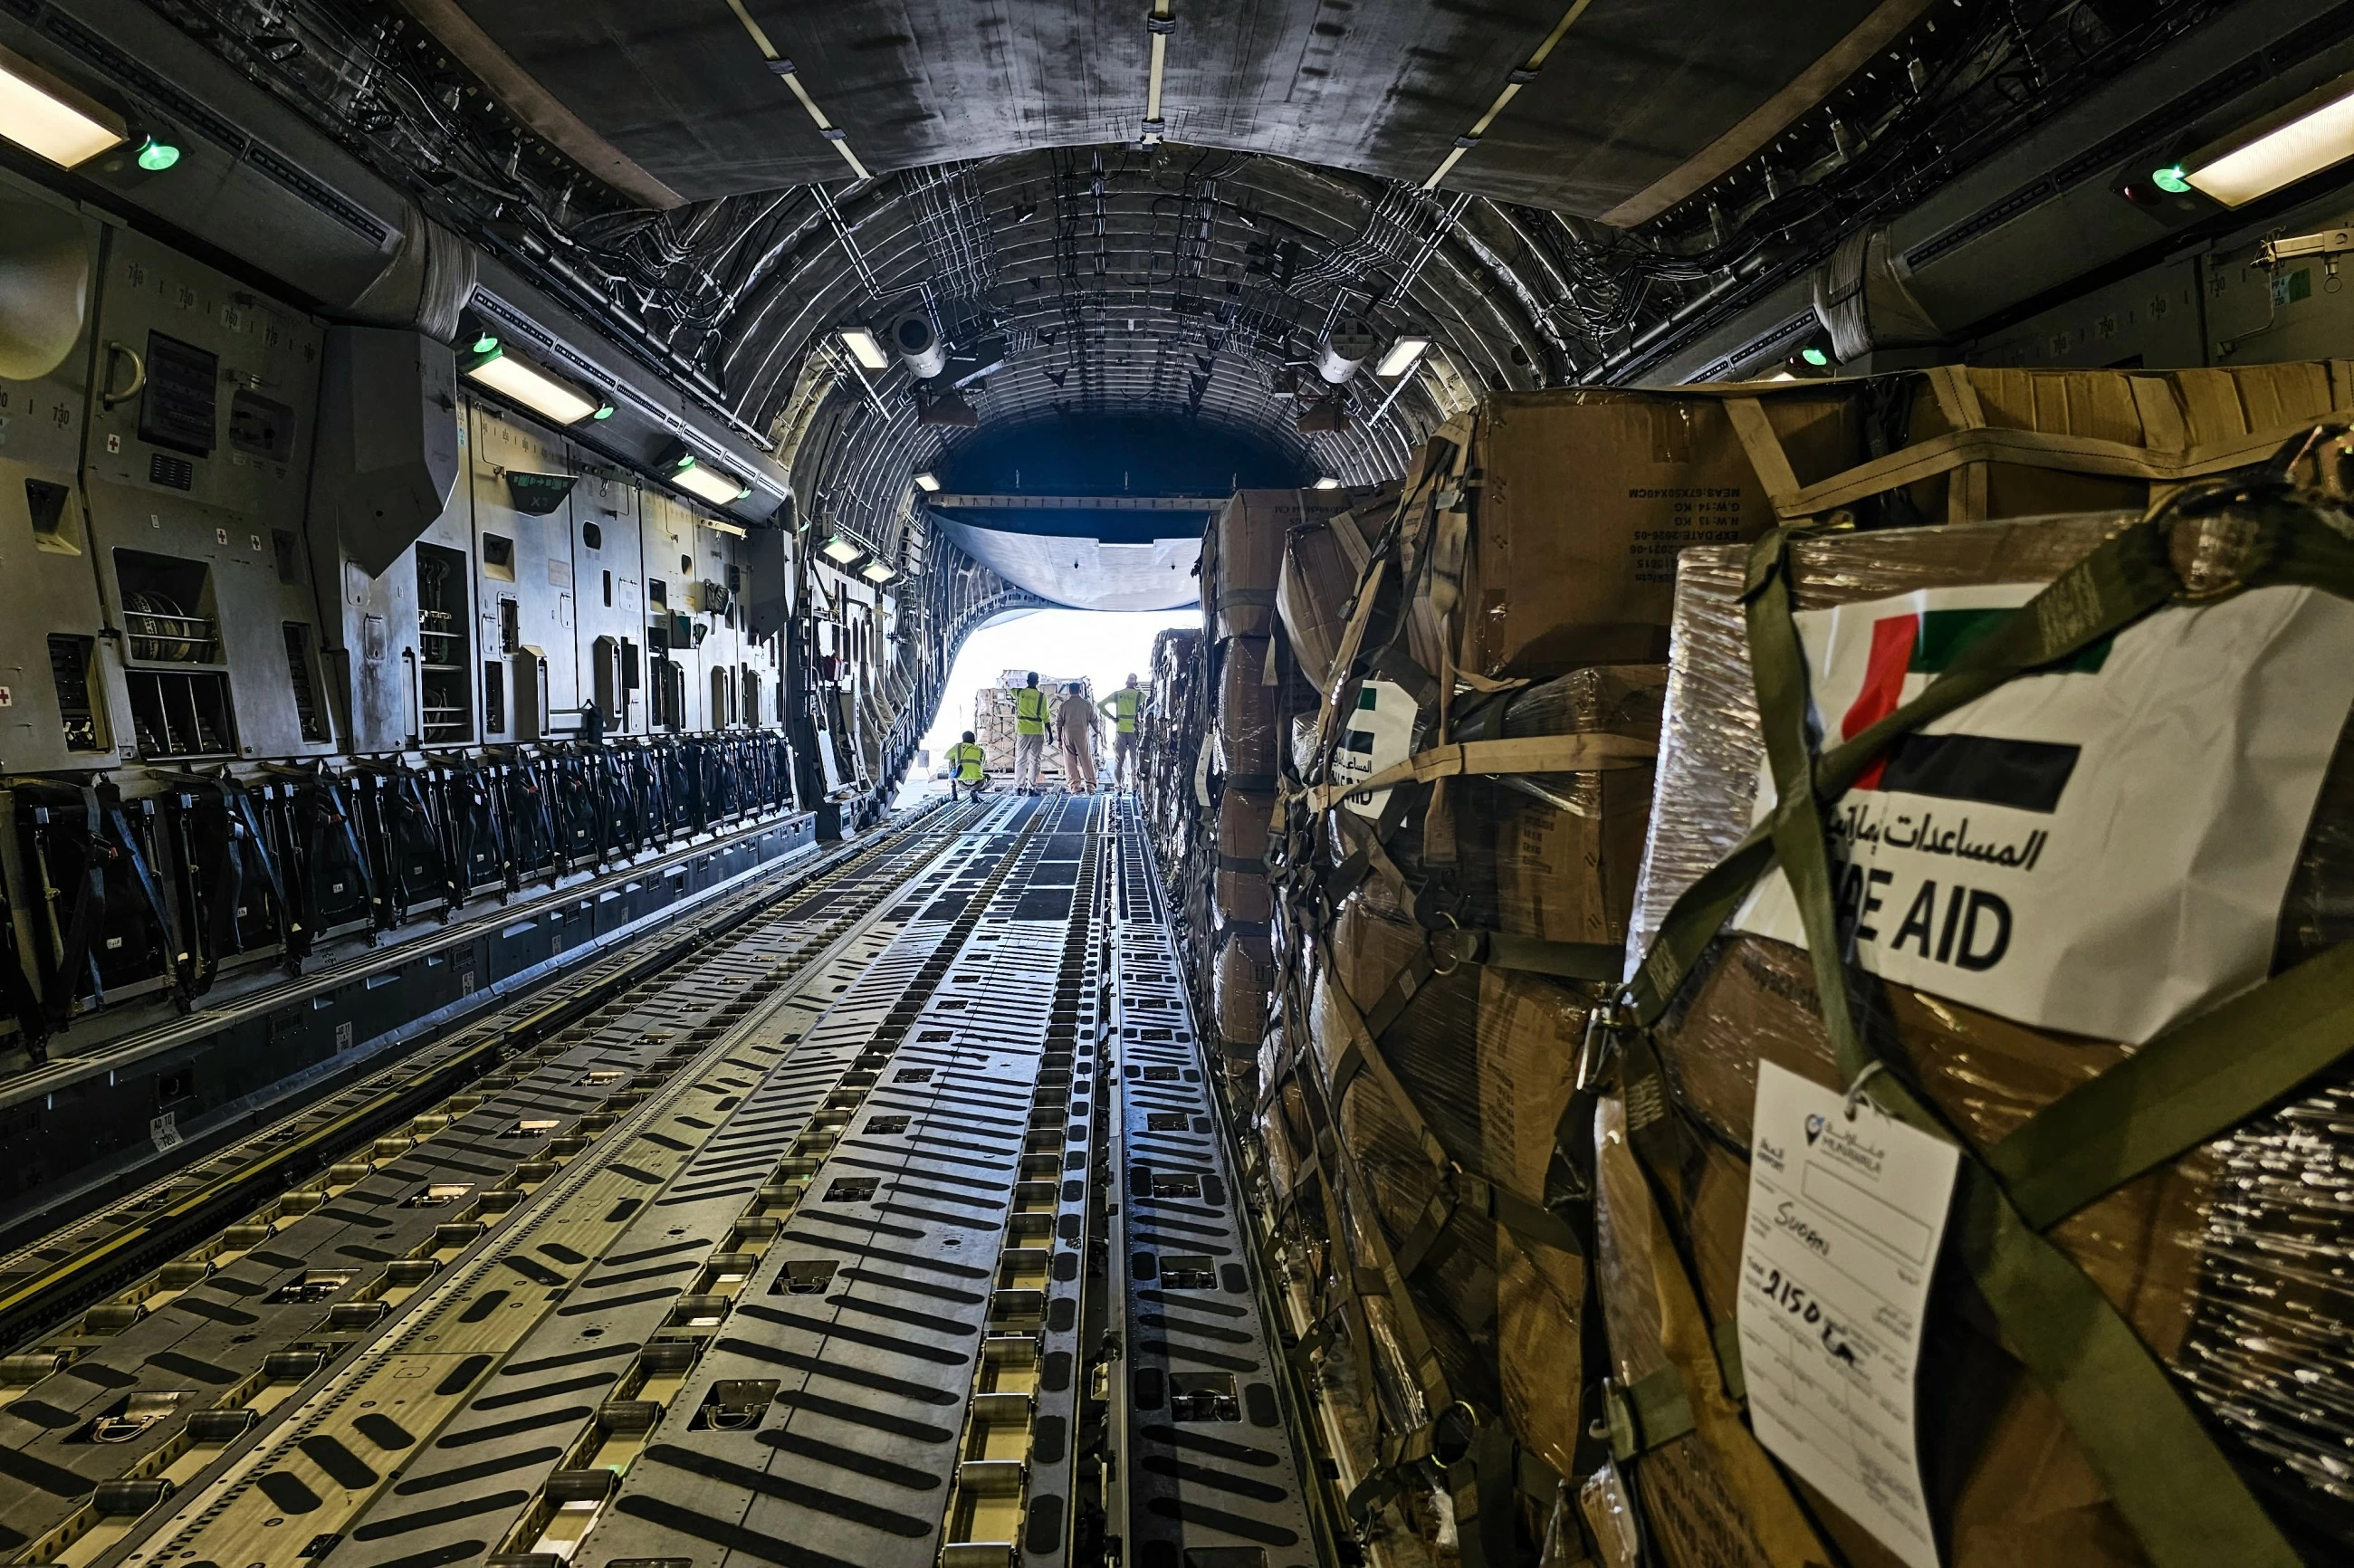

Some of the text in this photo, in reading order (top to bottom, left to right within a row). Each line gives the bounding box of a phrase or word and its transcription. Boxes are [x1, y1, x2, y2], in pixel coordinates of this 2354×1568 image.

[2208, 275, 2225, 293] 730
[53, 406, 70, 425] 730
[1674, 502, 1692, 512] KG
[1674, 516, 1692, 526] KG
[1883, 812, 2049, 873] المساعدات
[1832, 859, 2014, 972] AE AID
[153, 1114, 172, 1131] AD 10
[159, 1133, 176, 1148] 720
